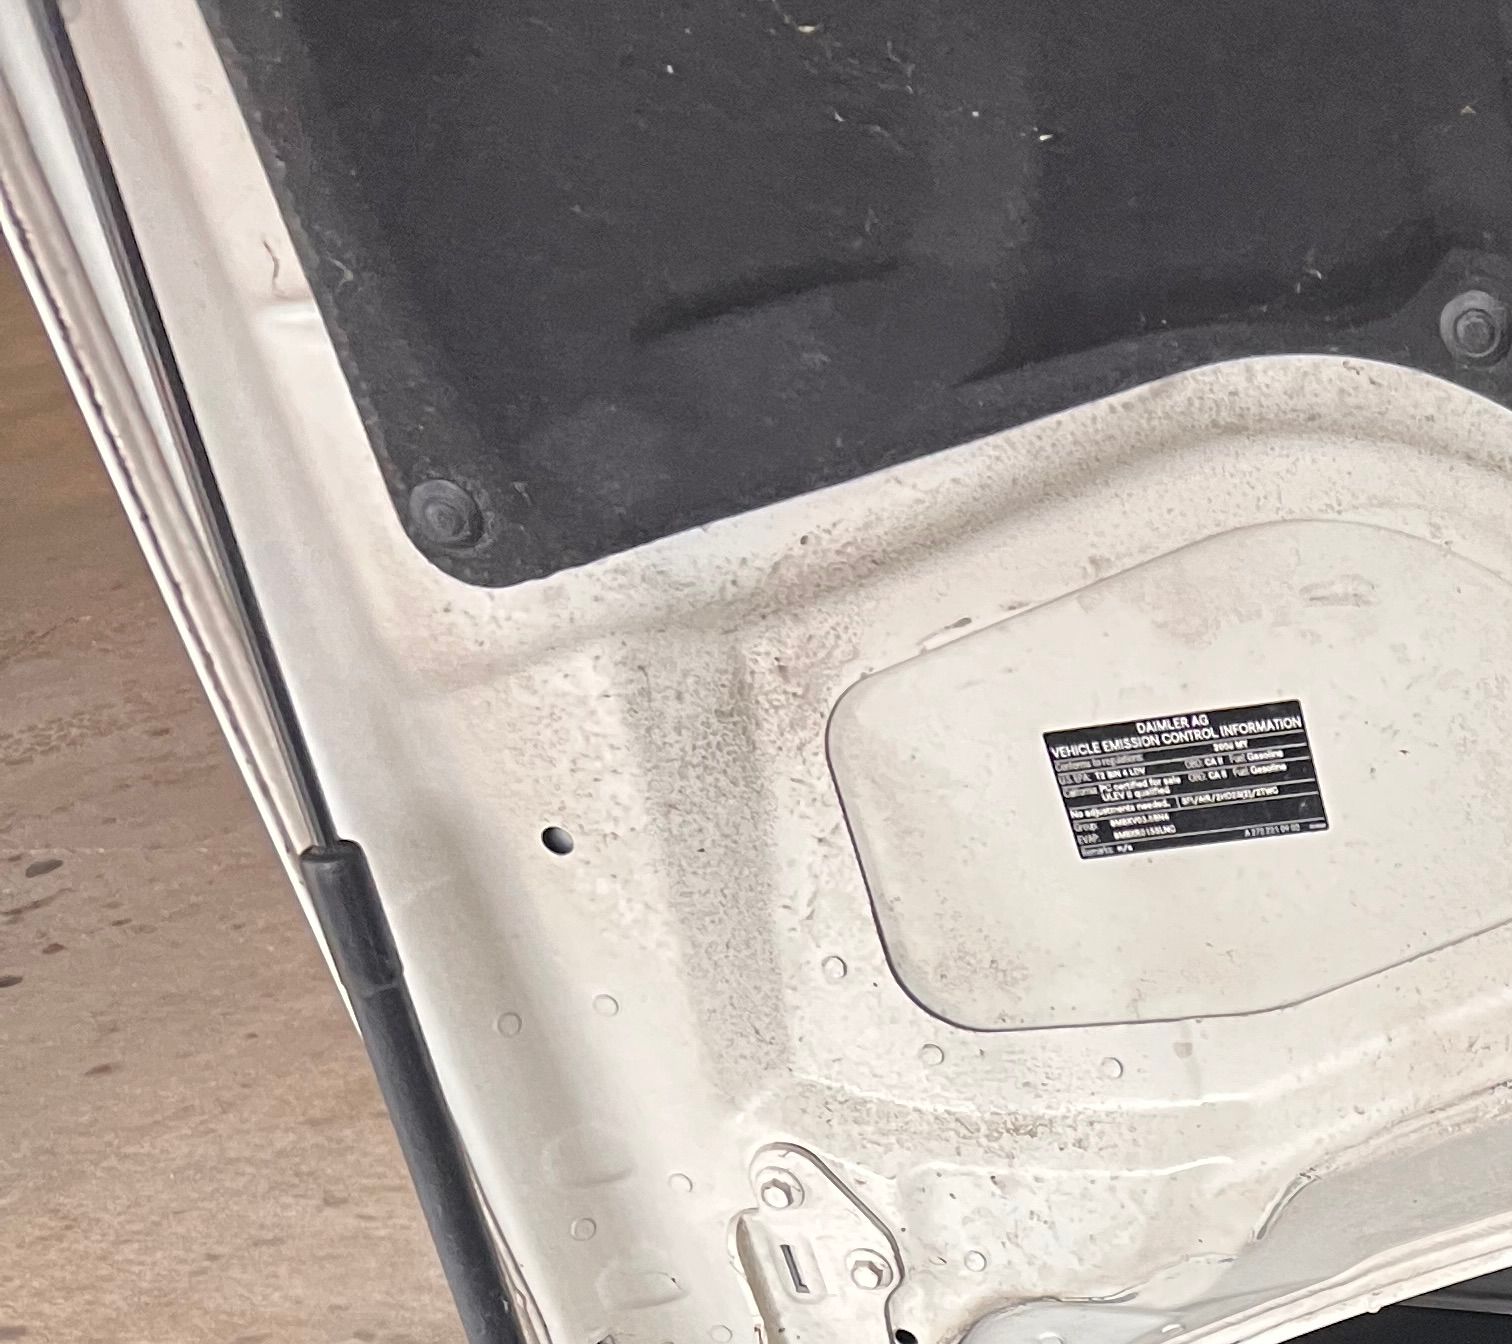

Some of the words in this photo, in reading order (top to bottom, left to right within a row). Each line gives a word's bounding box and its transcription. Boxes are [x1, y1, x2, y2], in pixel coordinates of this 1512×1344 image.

[1138, 718, 1188, 733] DAIMLER
[1191, 715, 1209, 726] AG
[1052, 743, 1101, 759] VEHICLE
[1103, 735, 1159, 752] EMISSION
[1162, 727, 1218, 744] CONTROL
[1221, 717, 1300, 737] INFORMATION
[1204, 758, 1217, 766] CA
[1248, 751, 1283, 762] Gasoline
[1251, 764, 1286, 775] Gasoline
[1208, 771, 1220, 780] CA
[1070, 810, 1083, 819] No
[1085, 805, 1135, 819] adjustments
